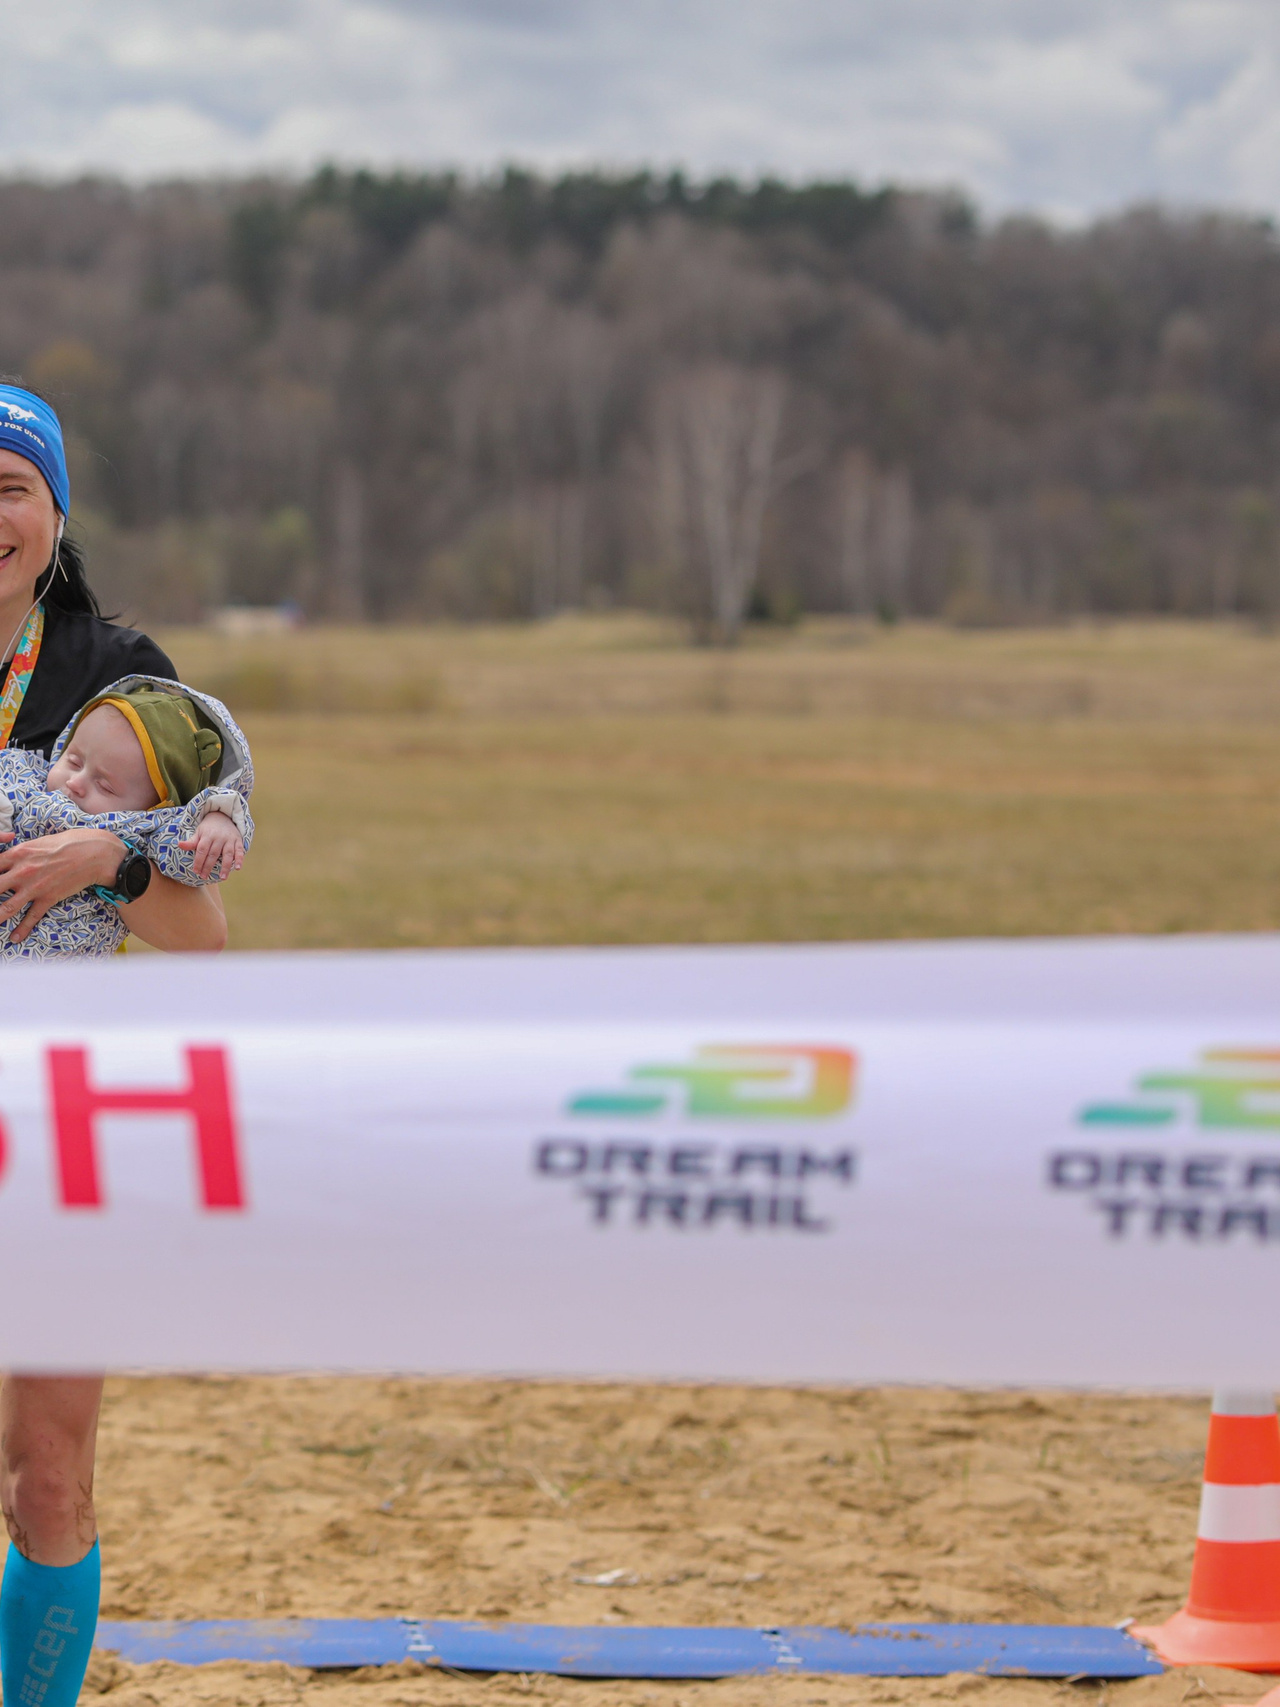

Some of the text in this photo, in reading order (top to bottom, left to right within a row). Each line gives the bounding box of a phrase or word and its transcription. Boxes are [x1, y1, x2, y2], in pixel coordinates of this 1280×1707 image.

[4, 422, 23, 431] FOX
[24, 429, 45, 448] ULTRA
[22, 640, 34, 658] ЛЕС
[534, 1138, 856, 1184] DREAM
[580, 1185, 832, 1232] TRAIL
[27, 1605, 80, 1678] cep
